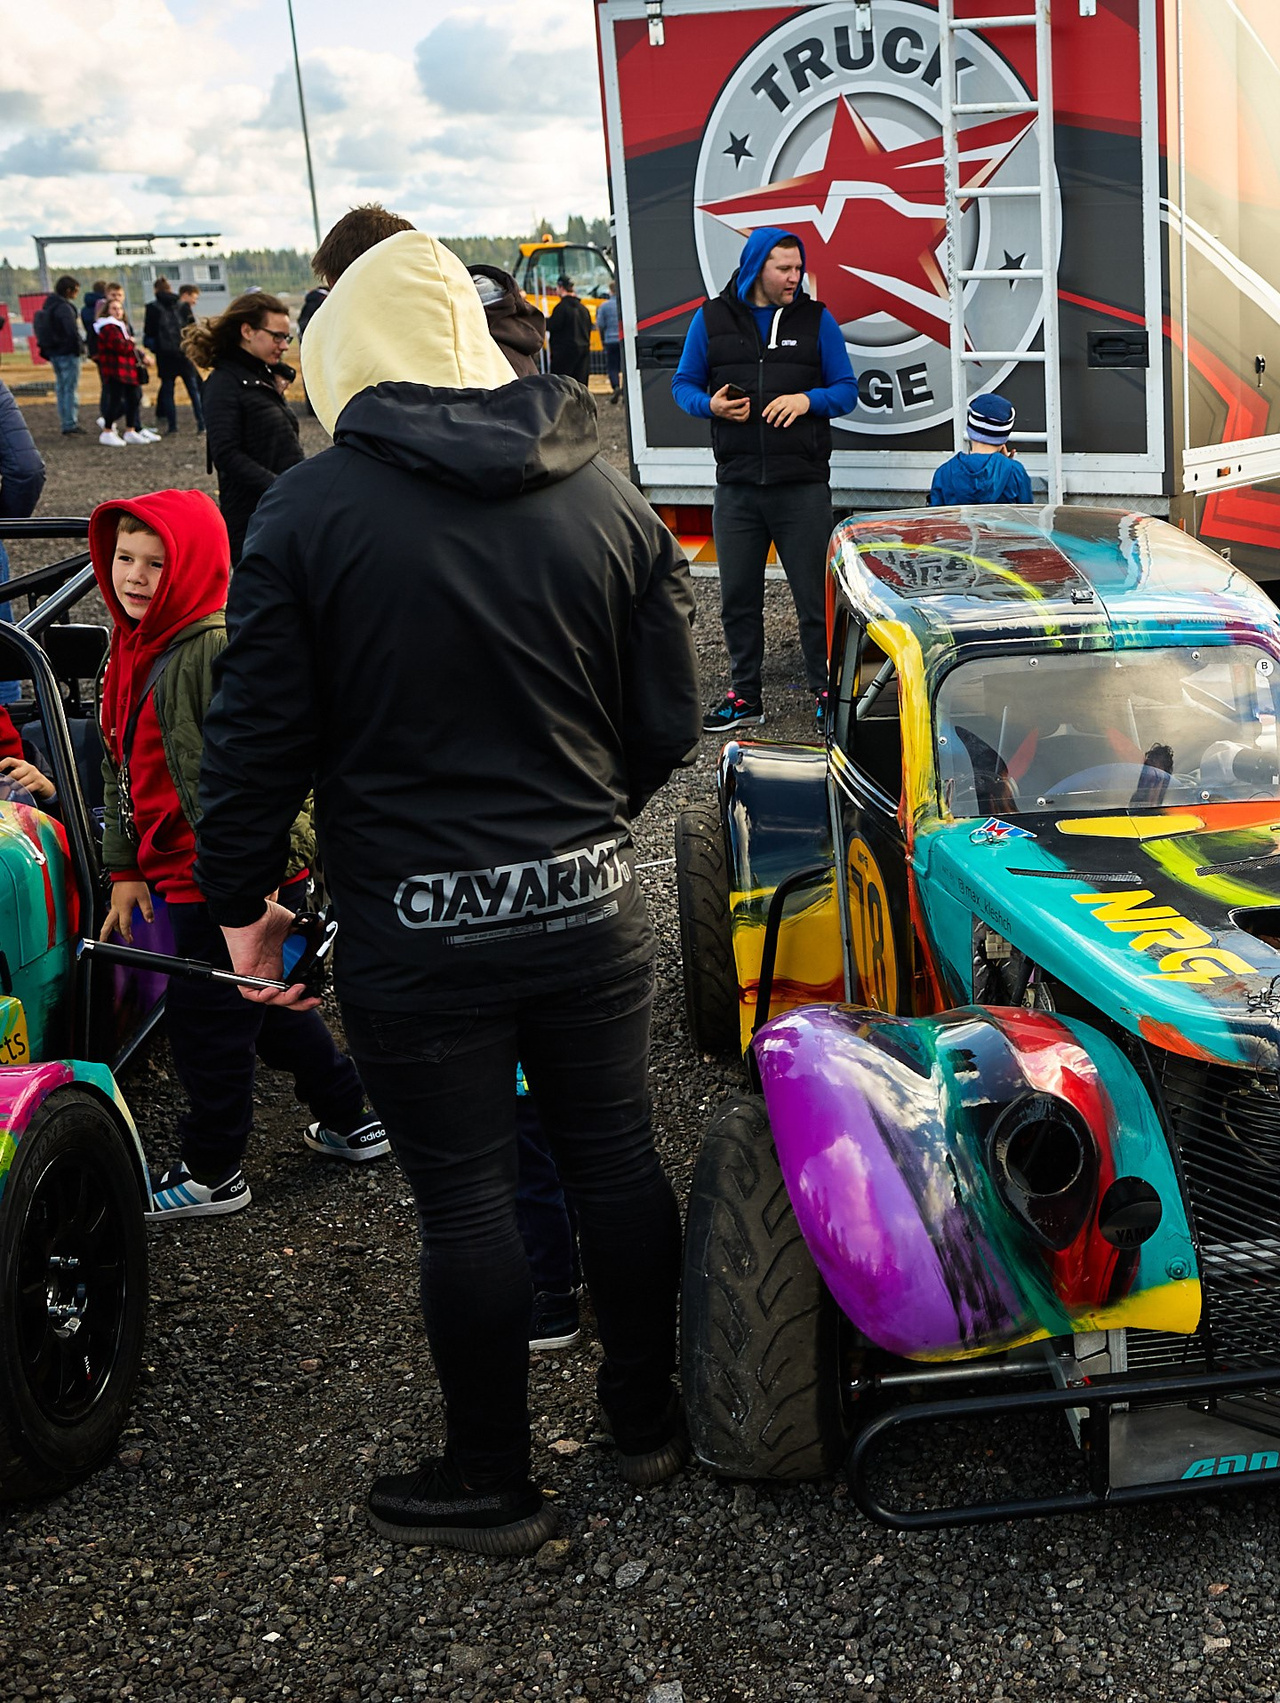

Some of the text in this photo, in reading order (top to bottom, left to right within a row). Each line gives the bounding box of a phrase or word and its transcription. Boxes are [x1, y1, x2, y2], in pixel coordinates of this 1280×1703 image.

[1261, 661, 1269, 670] B
[1070, 889, 1260, 985] NRG
[0, 1033, 26, 1065] ts
[360, 1129, 386, 1143] adida
